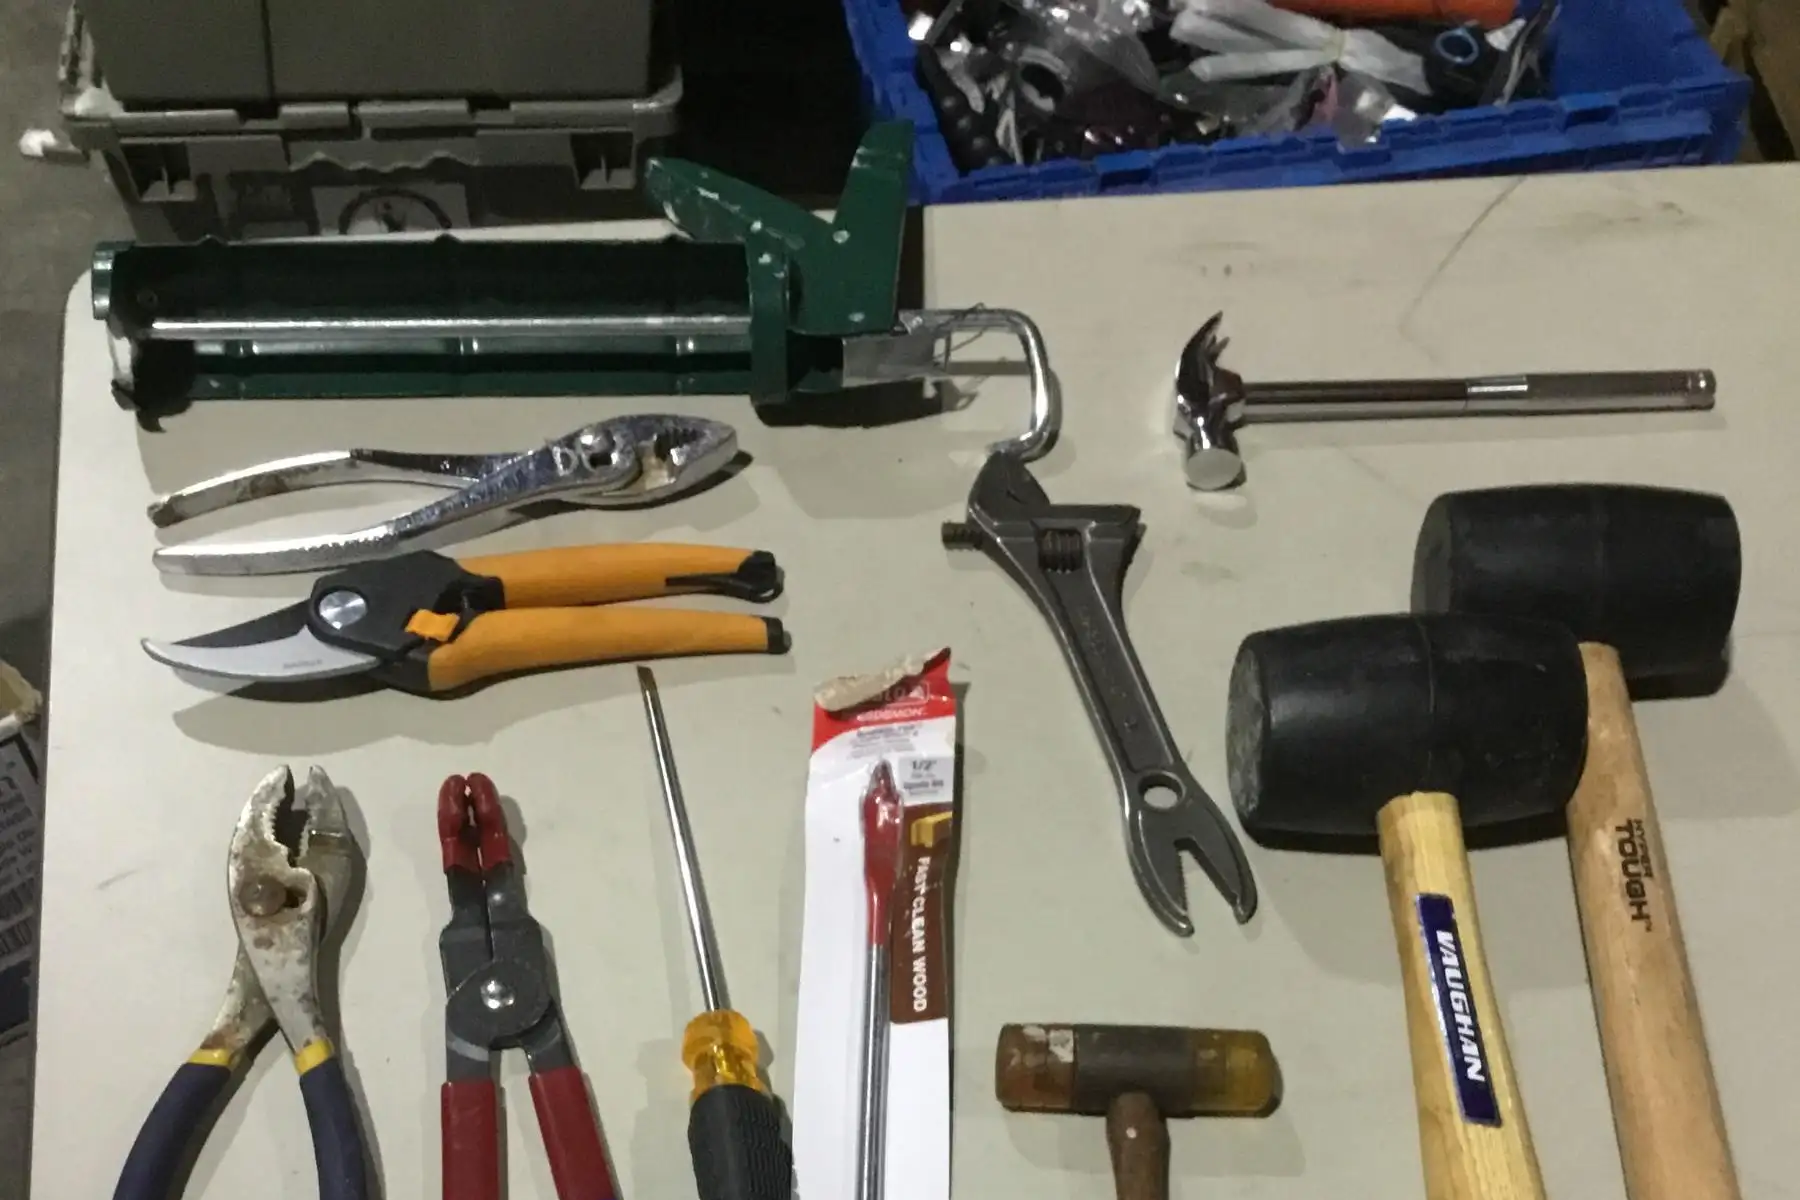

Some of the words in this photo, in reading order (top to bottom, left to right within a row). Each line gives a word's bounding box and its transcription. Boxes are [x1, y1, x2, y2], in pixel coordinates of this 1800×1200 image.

[1615, 818, 1651, 921] TOUGH
[911, 896, 925, 954] CLEAN
[912, 956, 927, 1012] WOOD
[1436, 930, 1485, 1082] VAUGHAN
